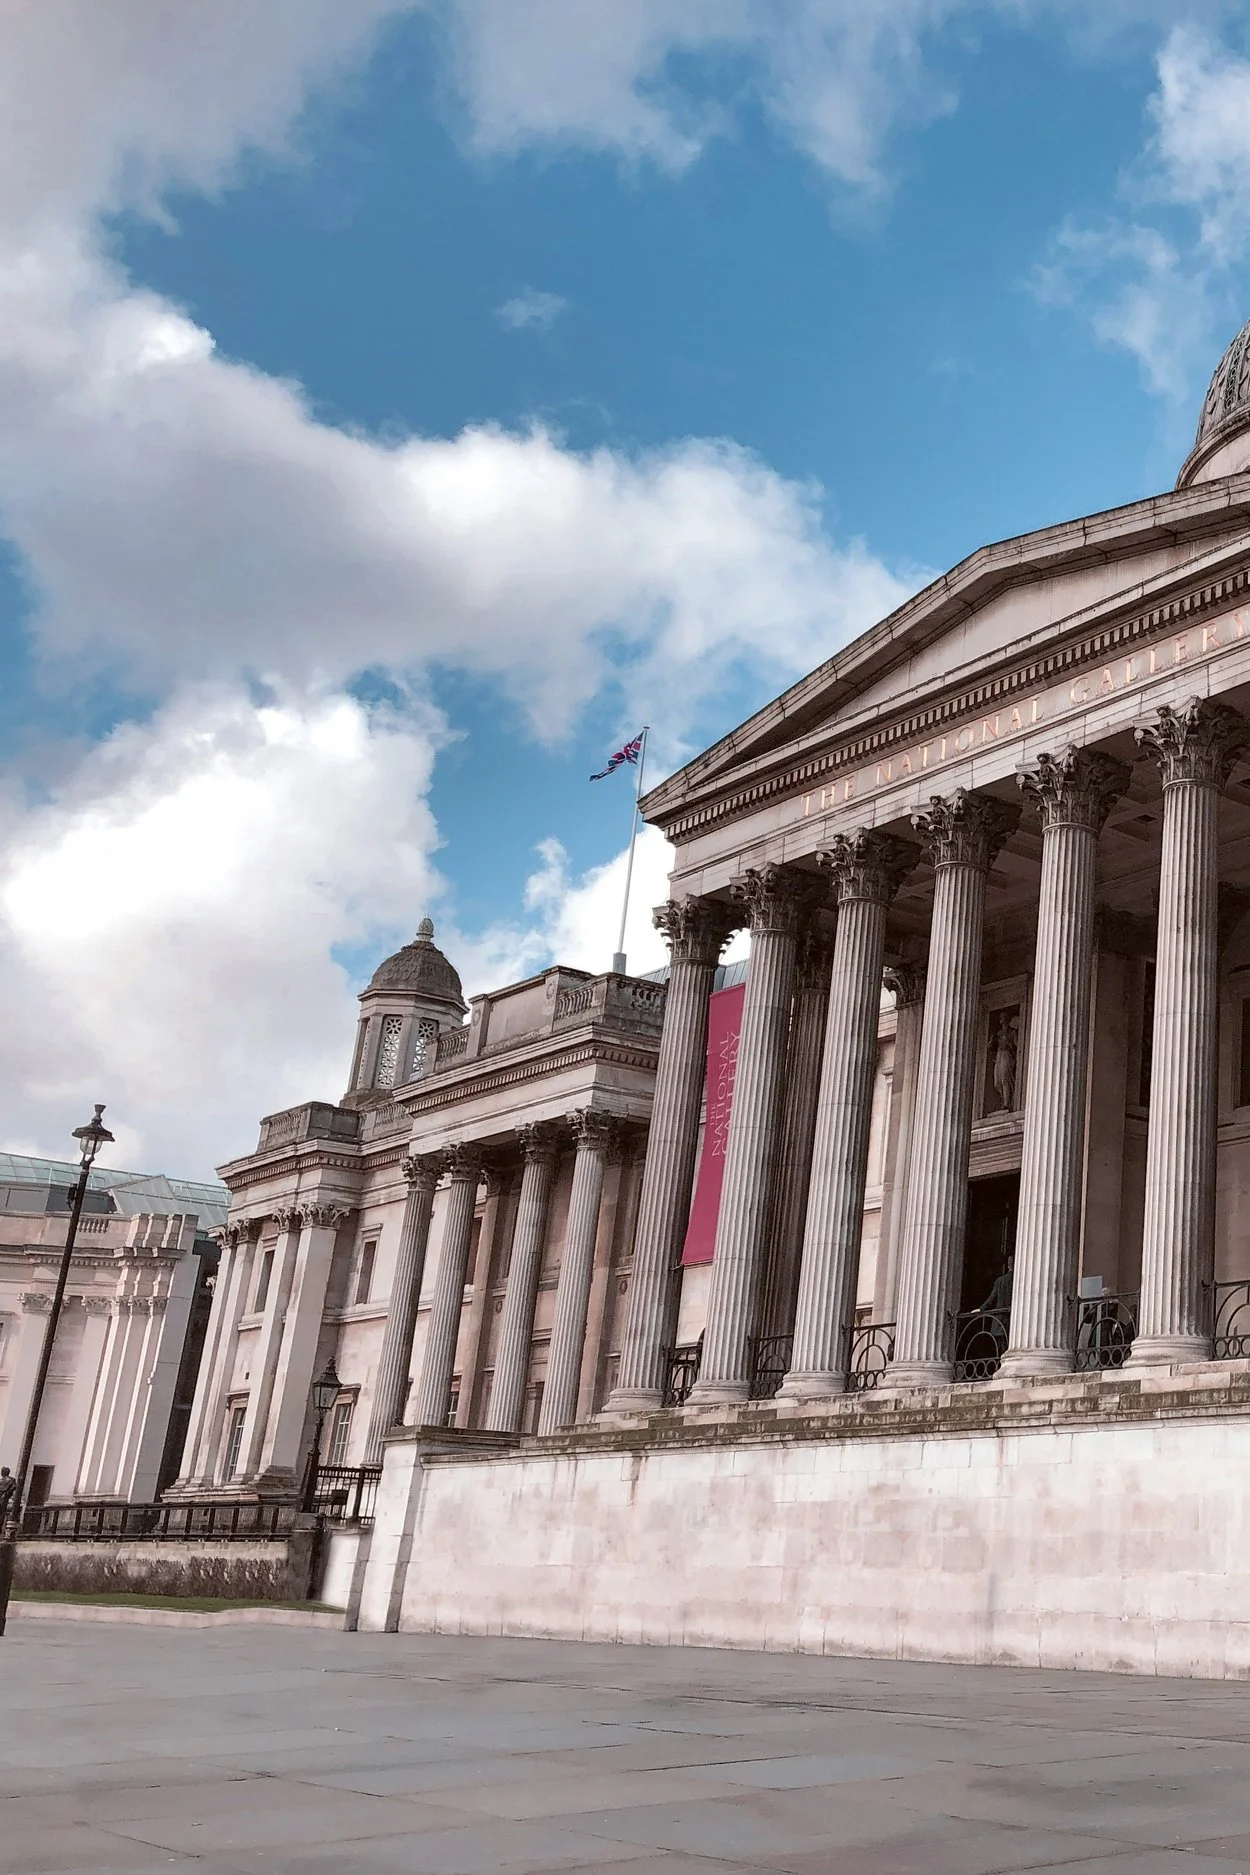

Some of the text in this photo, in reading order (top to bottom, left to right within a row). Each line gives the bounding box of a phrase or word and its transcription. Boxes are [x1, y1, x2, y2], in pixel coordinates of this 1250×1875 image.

[800, 608, 1250, 817] THE NATIONAL GALLERY
[712, 1032, 729, 1157] NATIONAL
